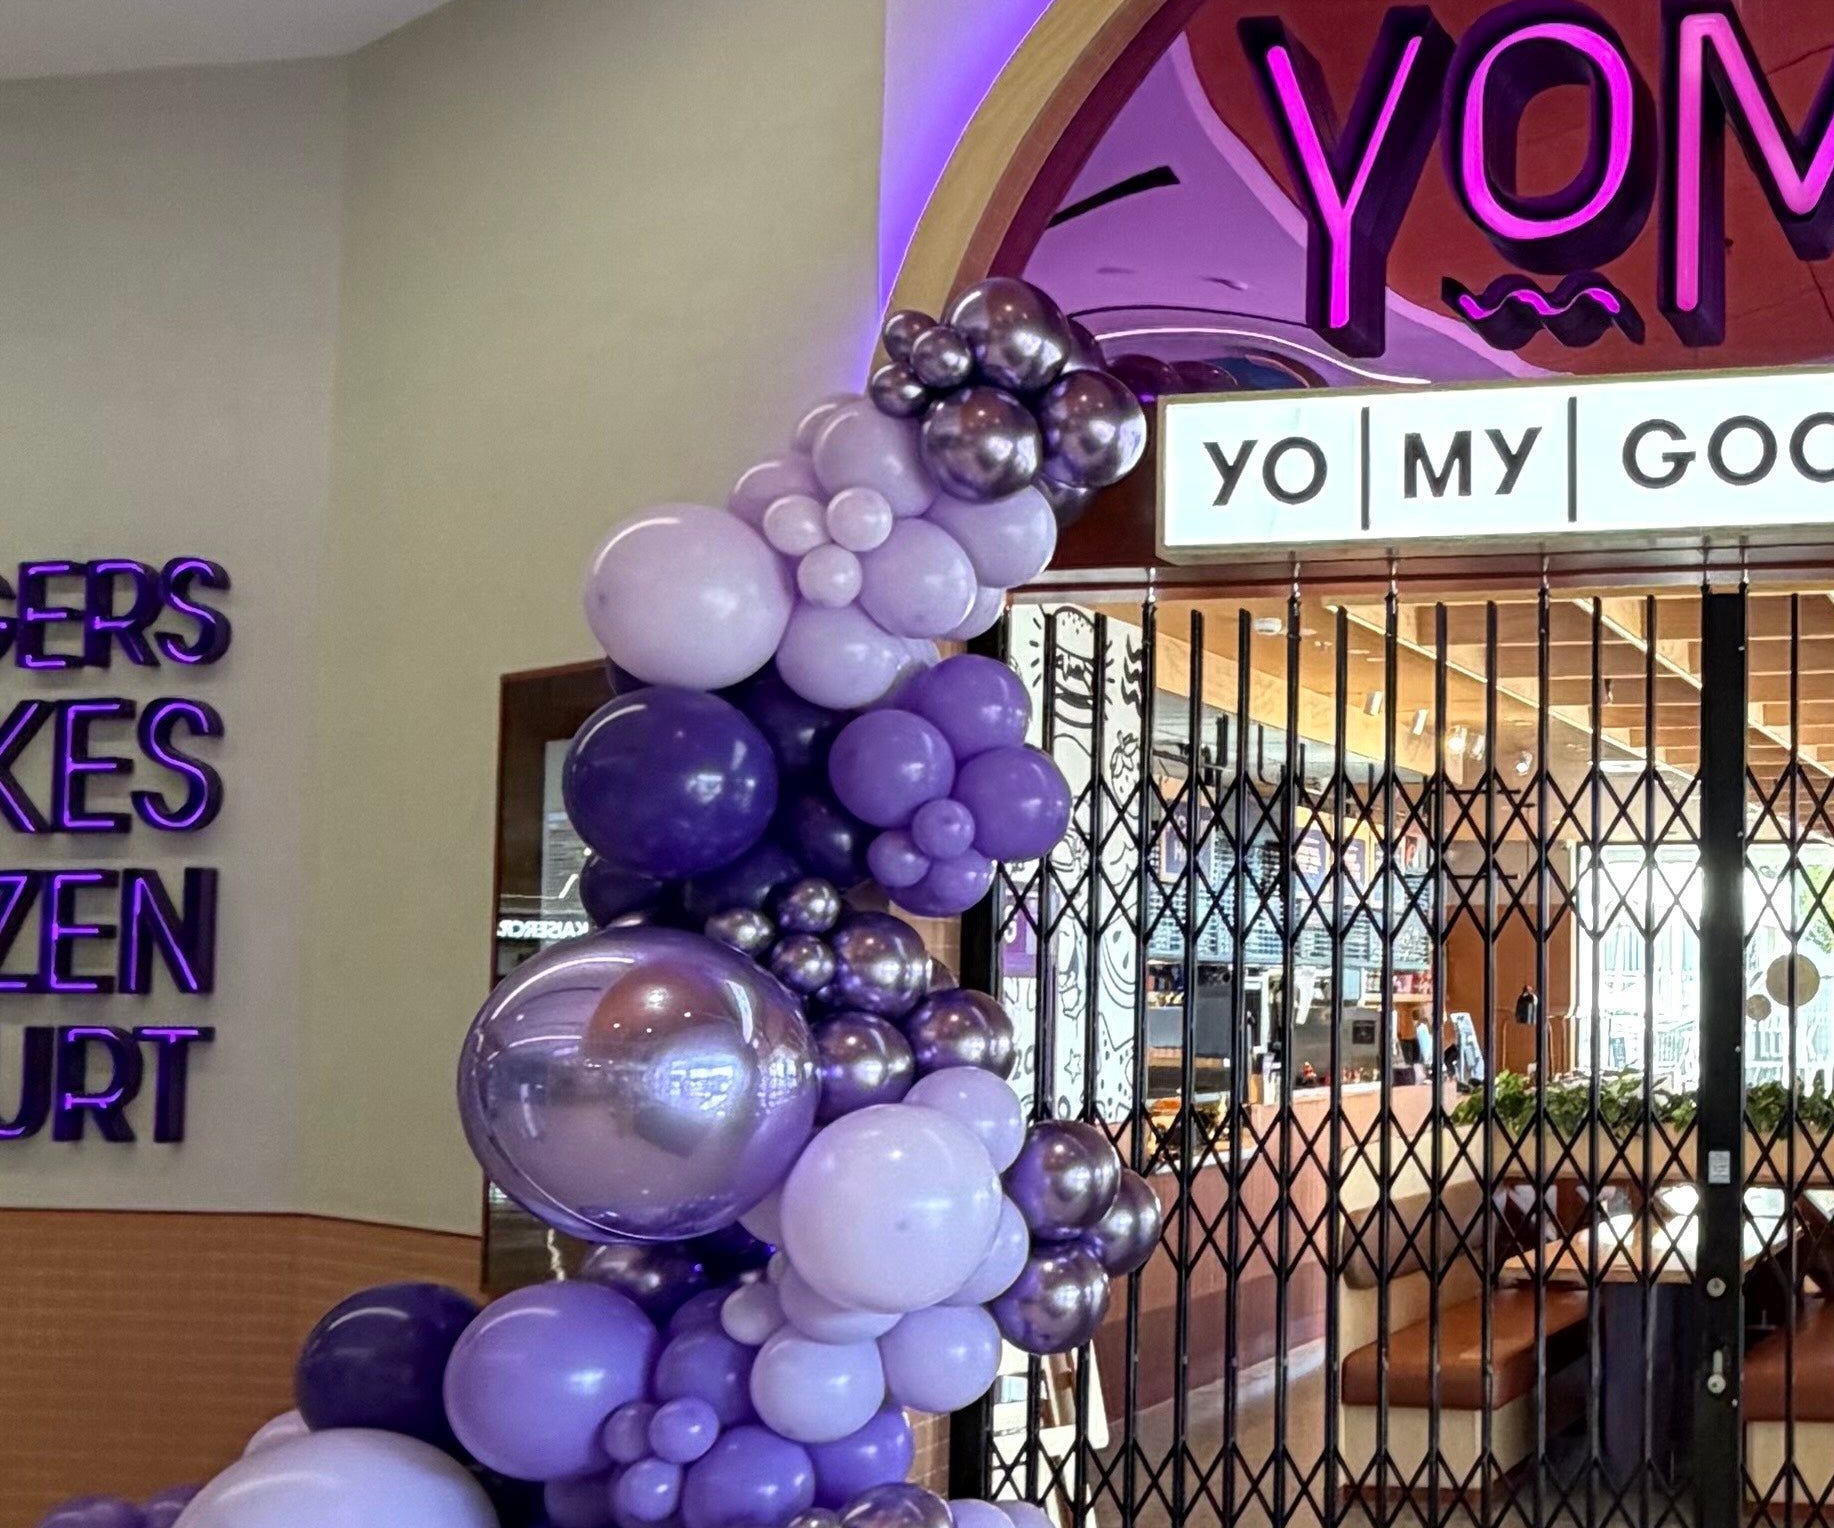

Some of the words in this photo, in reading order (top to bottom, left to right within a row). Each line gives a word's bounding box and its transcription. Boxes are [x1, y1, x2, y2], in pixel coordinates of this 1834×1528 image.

[1204, 434, 1329, 509] YO
[1403, 425, 1542, 499] MY
[0, 557, 232, 669] ERS
